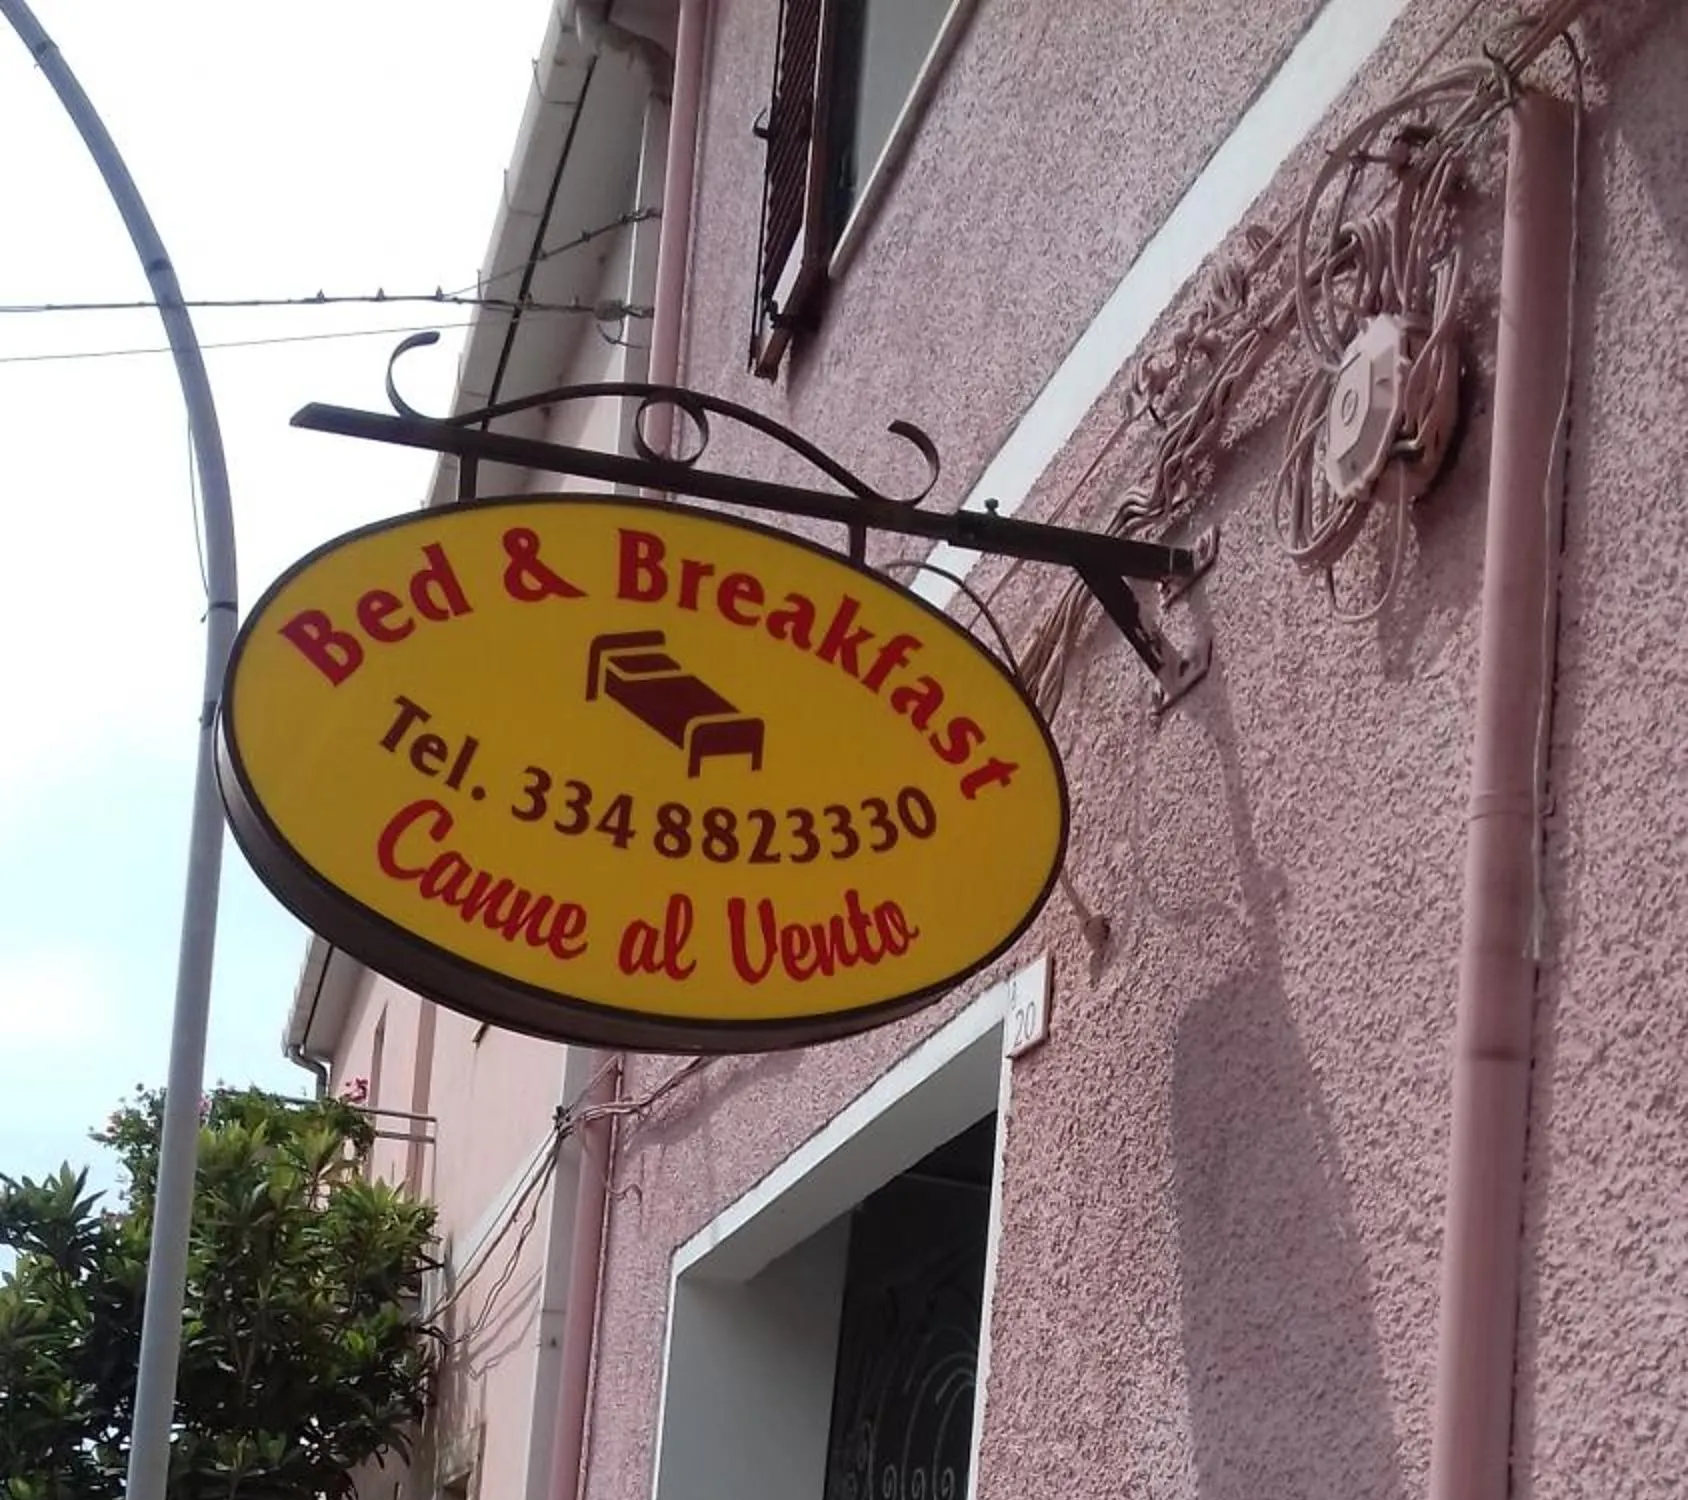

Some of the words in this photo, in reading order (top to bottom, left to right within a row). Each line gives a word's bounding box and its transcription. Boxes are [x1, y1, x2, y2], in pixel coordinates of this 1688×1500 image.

[277, 541, 474, 688] Bed
[502, 526, 589, 602] &
[616, 526, 1021, 802] Breakfast
[378, 695, 487, 802] Tel.
[376, 799, 589, 961] Canne
[617, 892, 698, 982] al
[726, 887, 922, 986] Vento
[1013, 1000, 1036, 1047] 20
